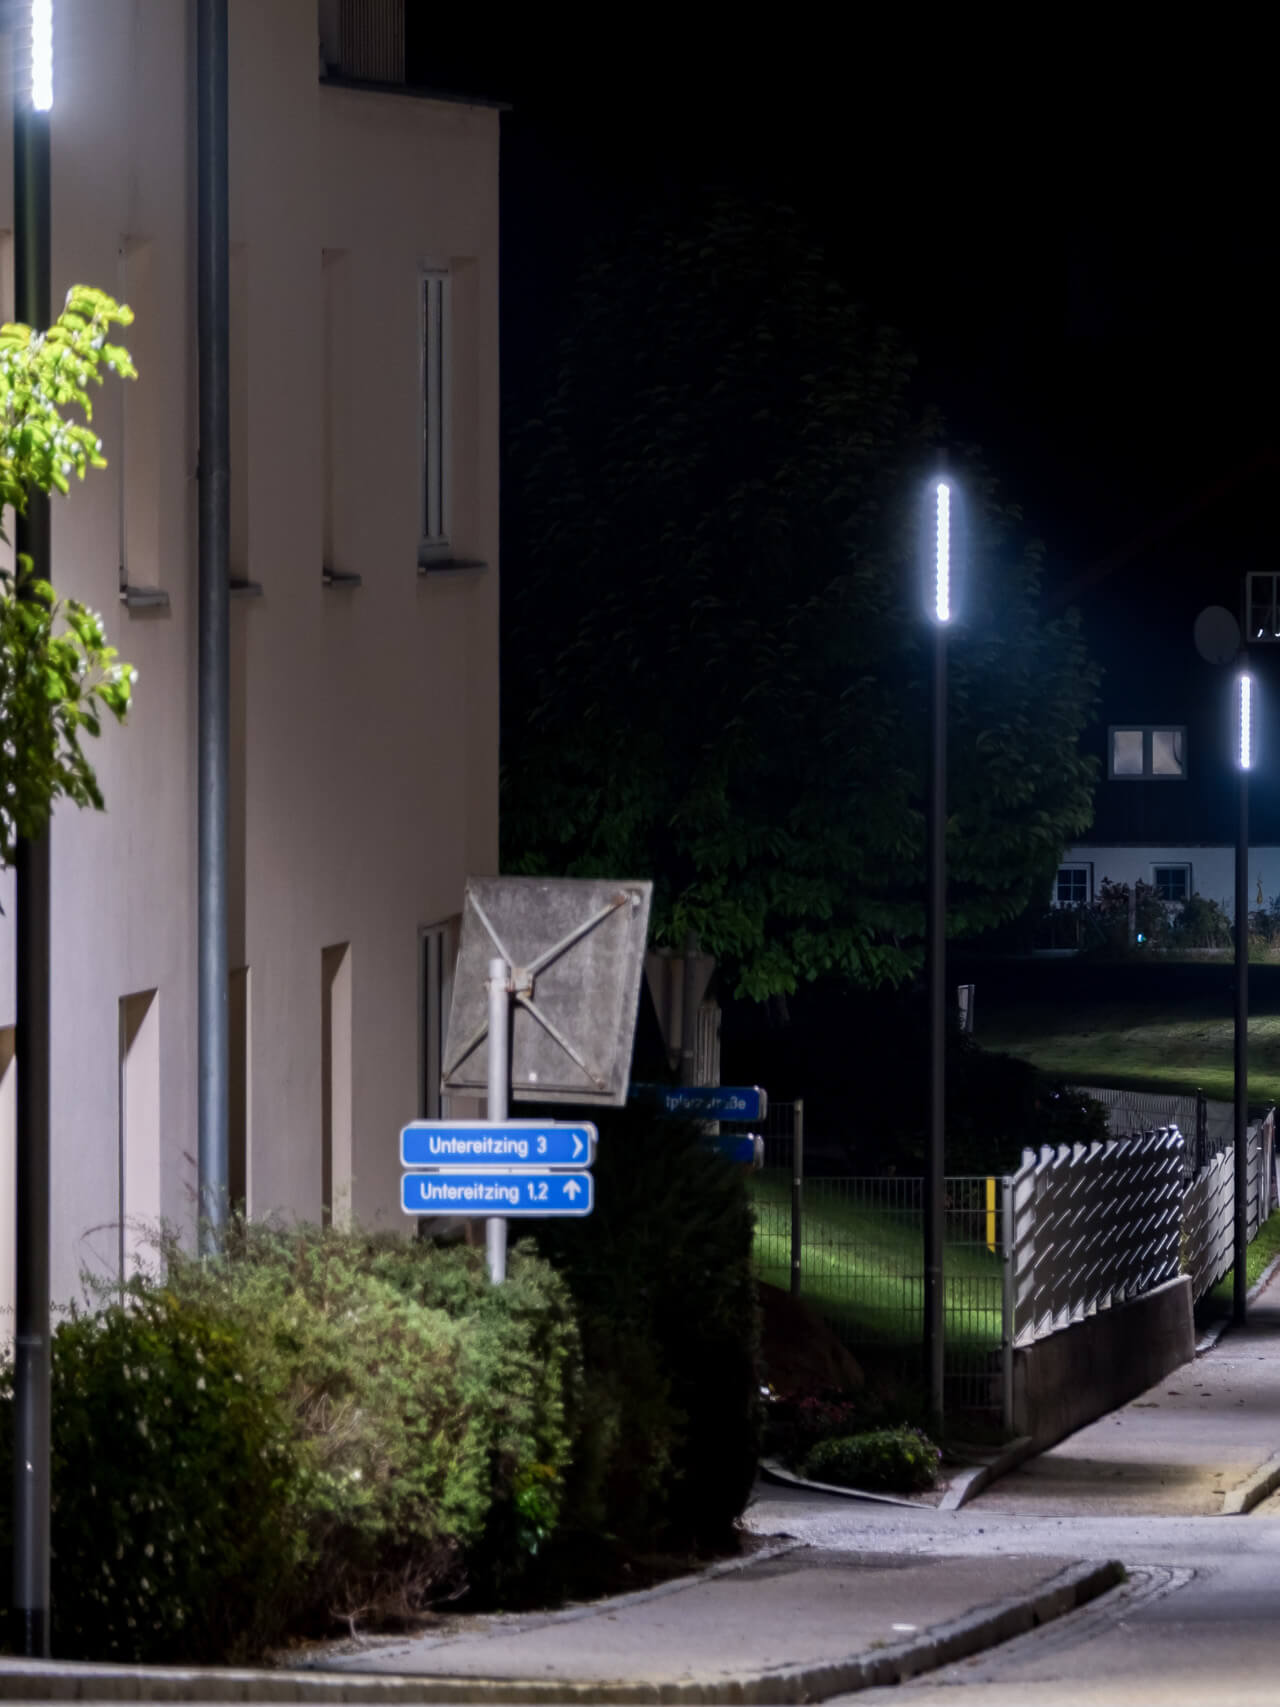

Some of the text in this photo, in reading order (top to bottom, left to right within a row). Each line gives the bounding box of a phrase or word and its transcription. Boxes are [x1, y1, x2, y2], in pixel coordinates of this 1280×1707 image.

[429, 1135, 547, 1158] Untereitzing 3
[420, 1182, 519, 1204] Untereitzing
